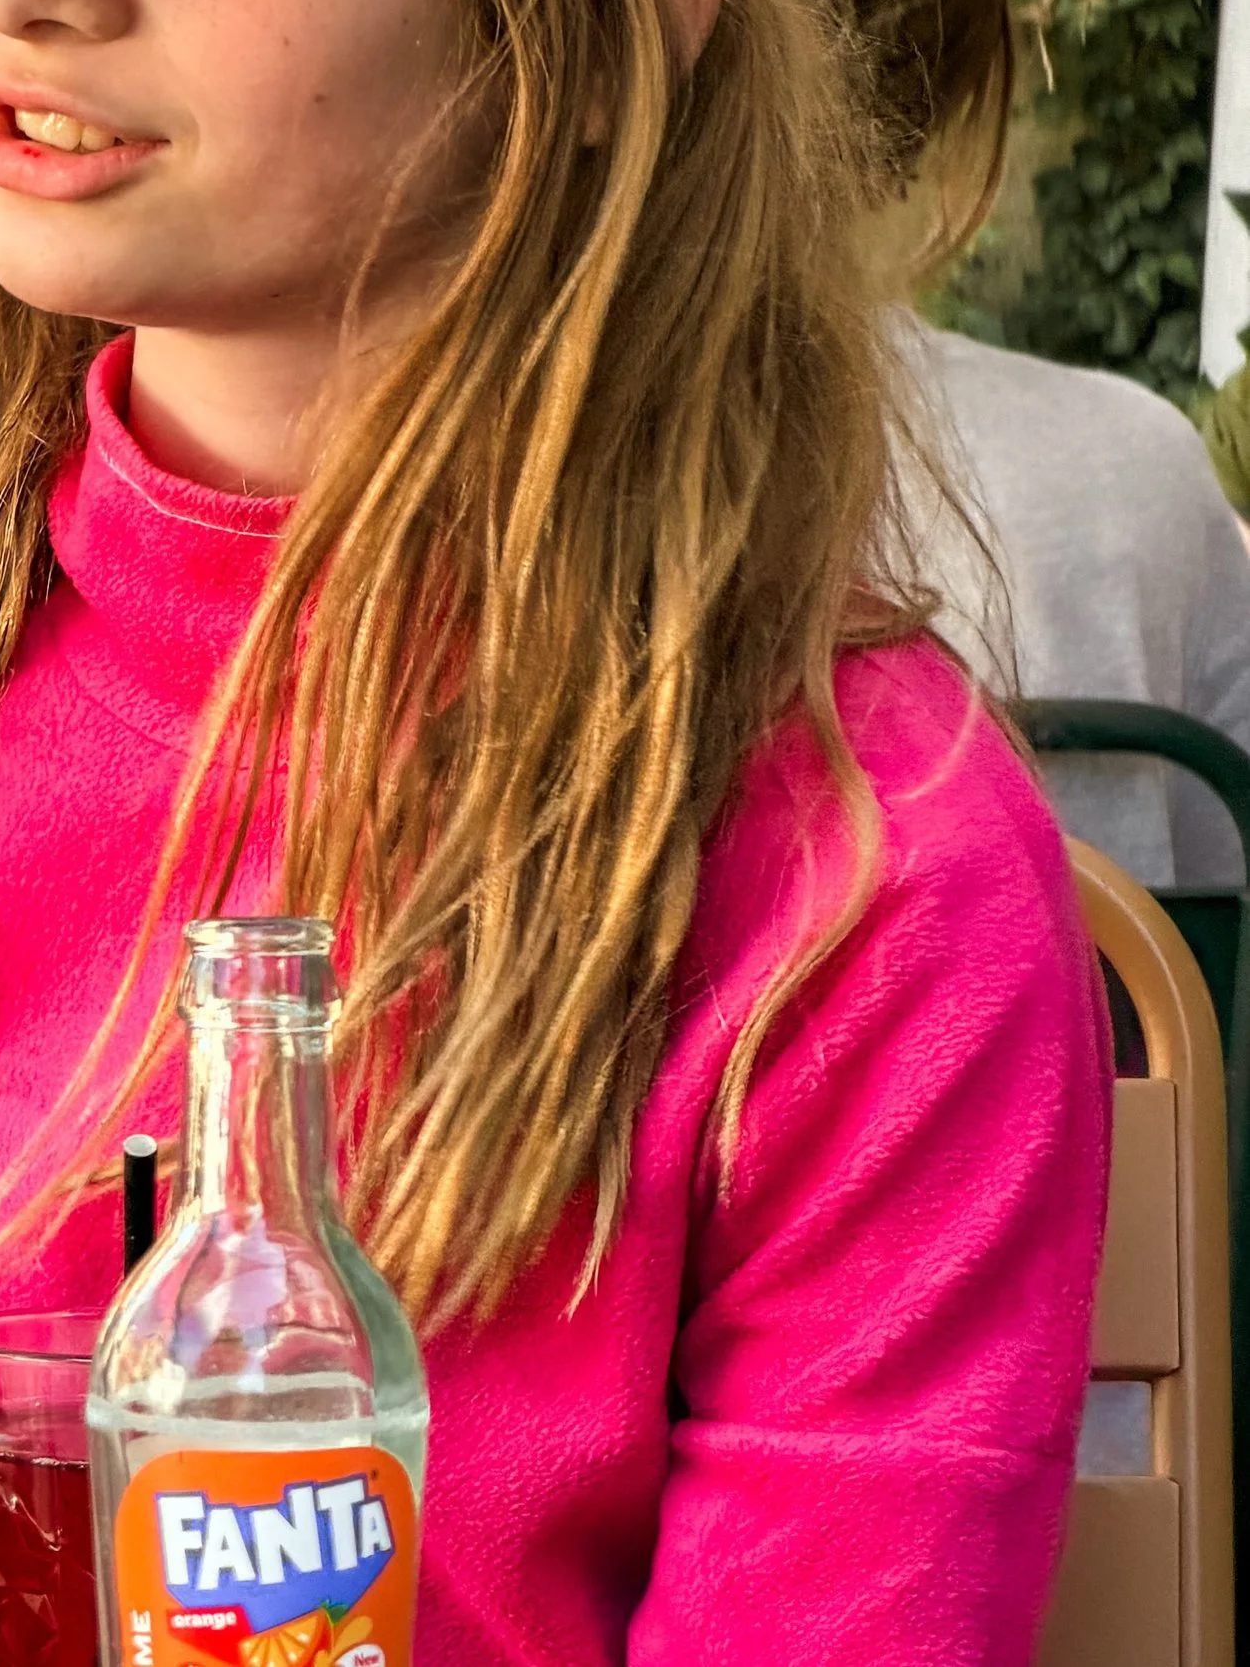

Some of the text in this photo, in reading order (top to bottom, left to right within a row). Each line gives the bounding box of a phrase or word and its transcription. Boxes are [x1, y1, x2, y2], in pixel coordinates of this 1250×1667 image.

[156, 1476, 394, 1591] FANTA
[131, 1608, 154, 1666] ME
[170, 1611, 237, 1630] orange
